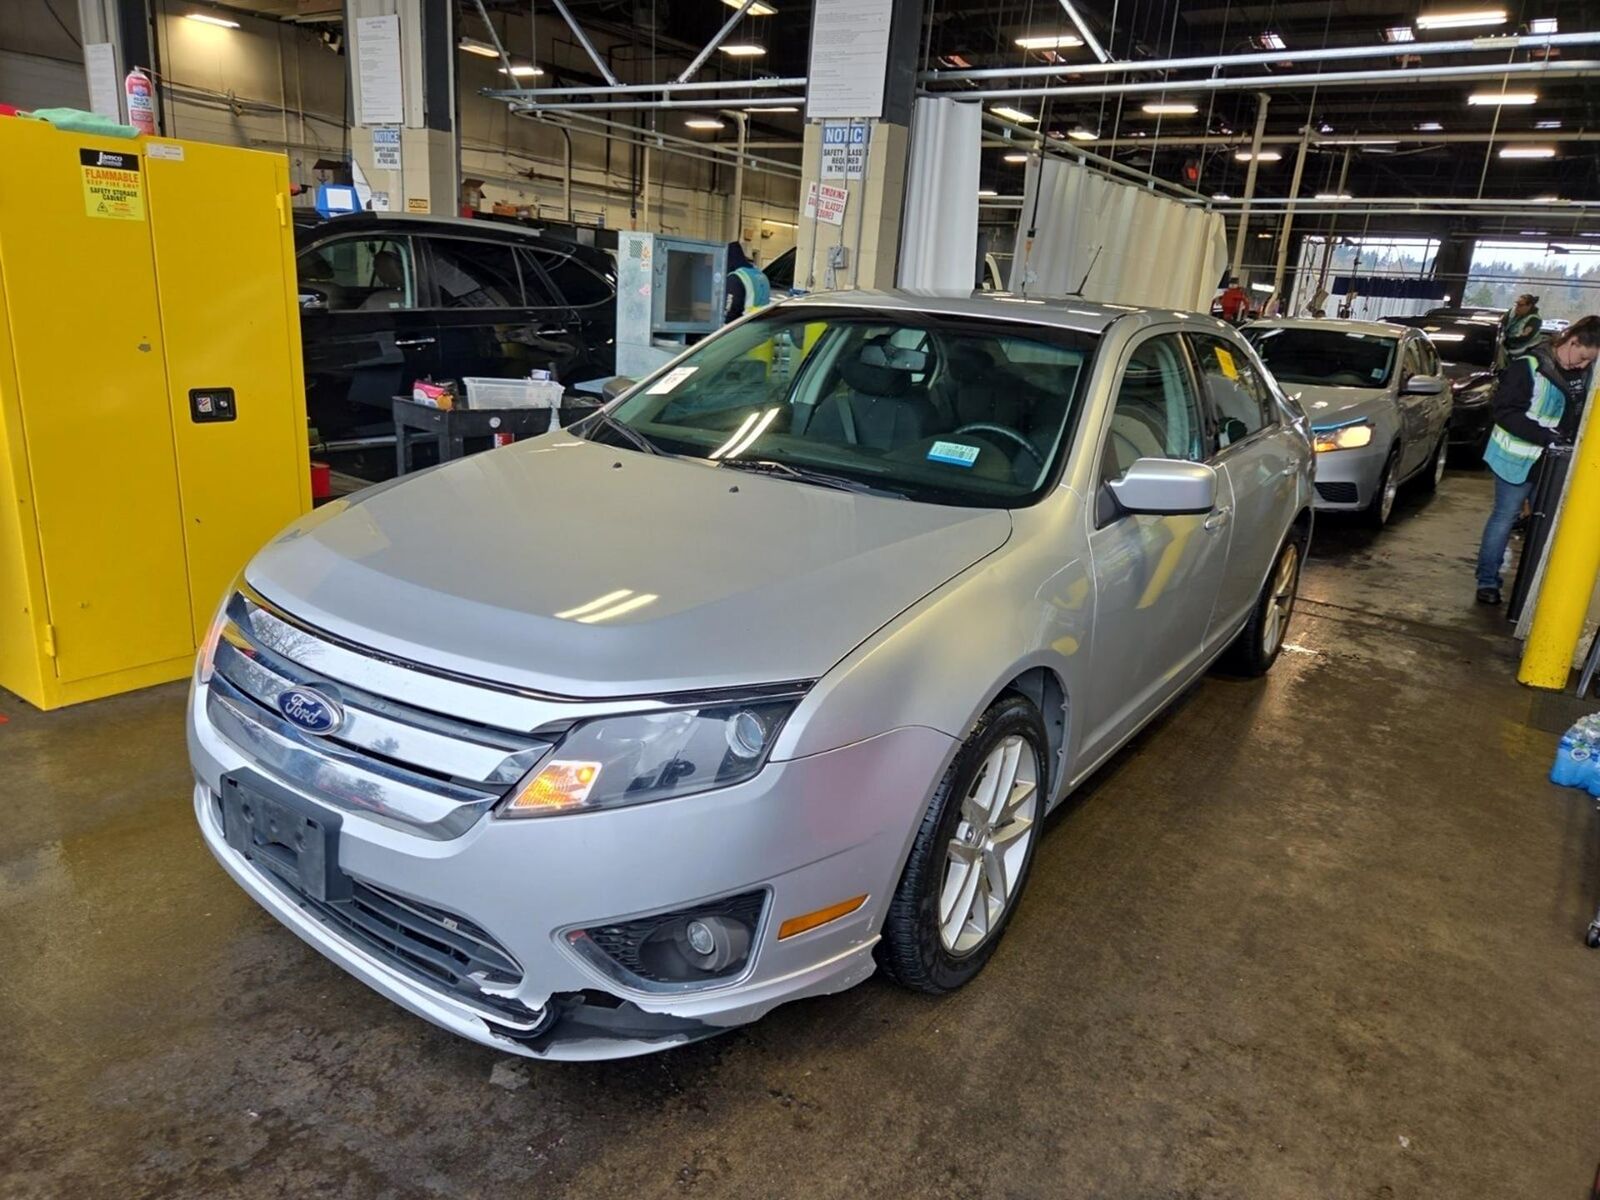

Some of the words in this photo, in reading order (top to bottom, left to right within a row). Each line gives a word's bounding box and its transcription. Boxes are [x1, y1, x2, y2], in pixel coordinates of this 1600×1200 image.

[374, 131, 400, 143] NOTICE
[825, 128, 865, 143] NOTIC
[85, 168, 139, 183] FLAMMABLE
[90, 187, 111, 195] SAFETY
[112, 189, 138, 198] STORAGE
[102, 194, 127, 202] CABINET
[820, 186, 846, 200] SMOKING
[285, 693, 322, 725] Ford
